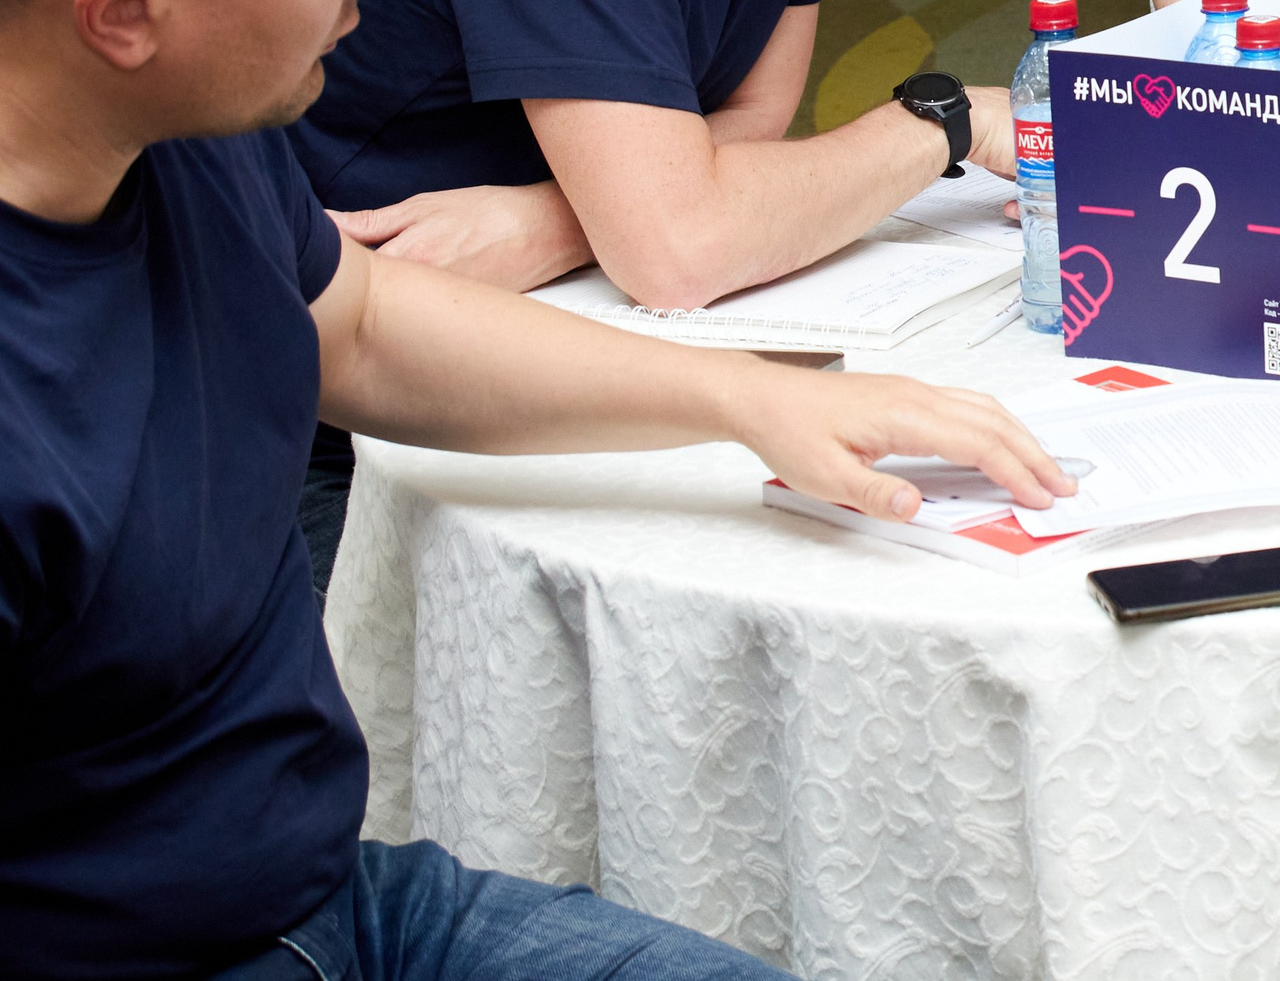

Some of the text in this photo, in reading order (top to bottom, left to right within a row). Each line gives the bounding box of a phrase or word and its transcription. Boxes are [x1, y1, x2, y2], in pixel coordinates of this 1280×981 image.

[1073, 76, 1133, 105] #МЫ
[1018, 132, 1054, 150] MEVE
[1159, 166, 1221, 284] 2
[1263, 298, 1279, 308] Сайт
[1264, 308, 1277, 318] Код
